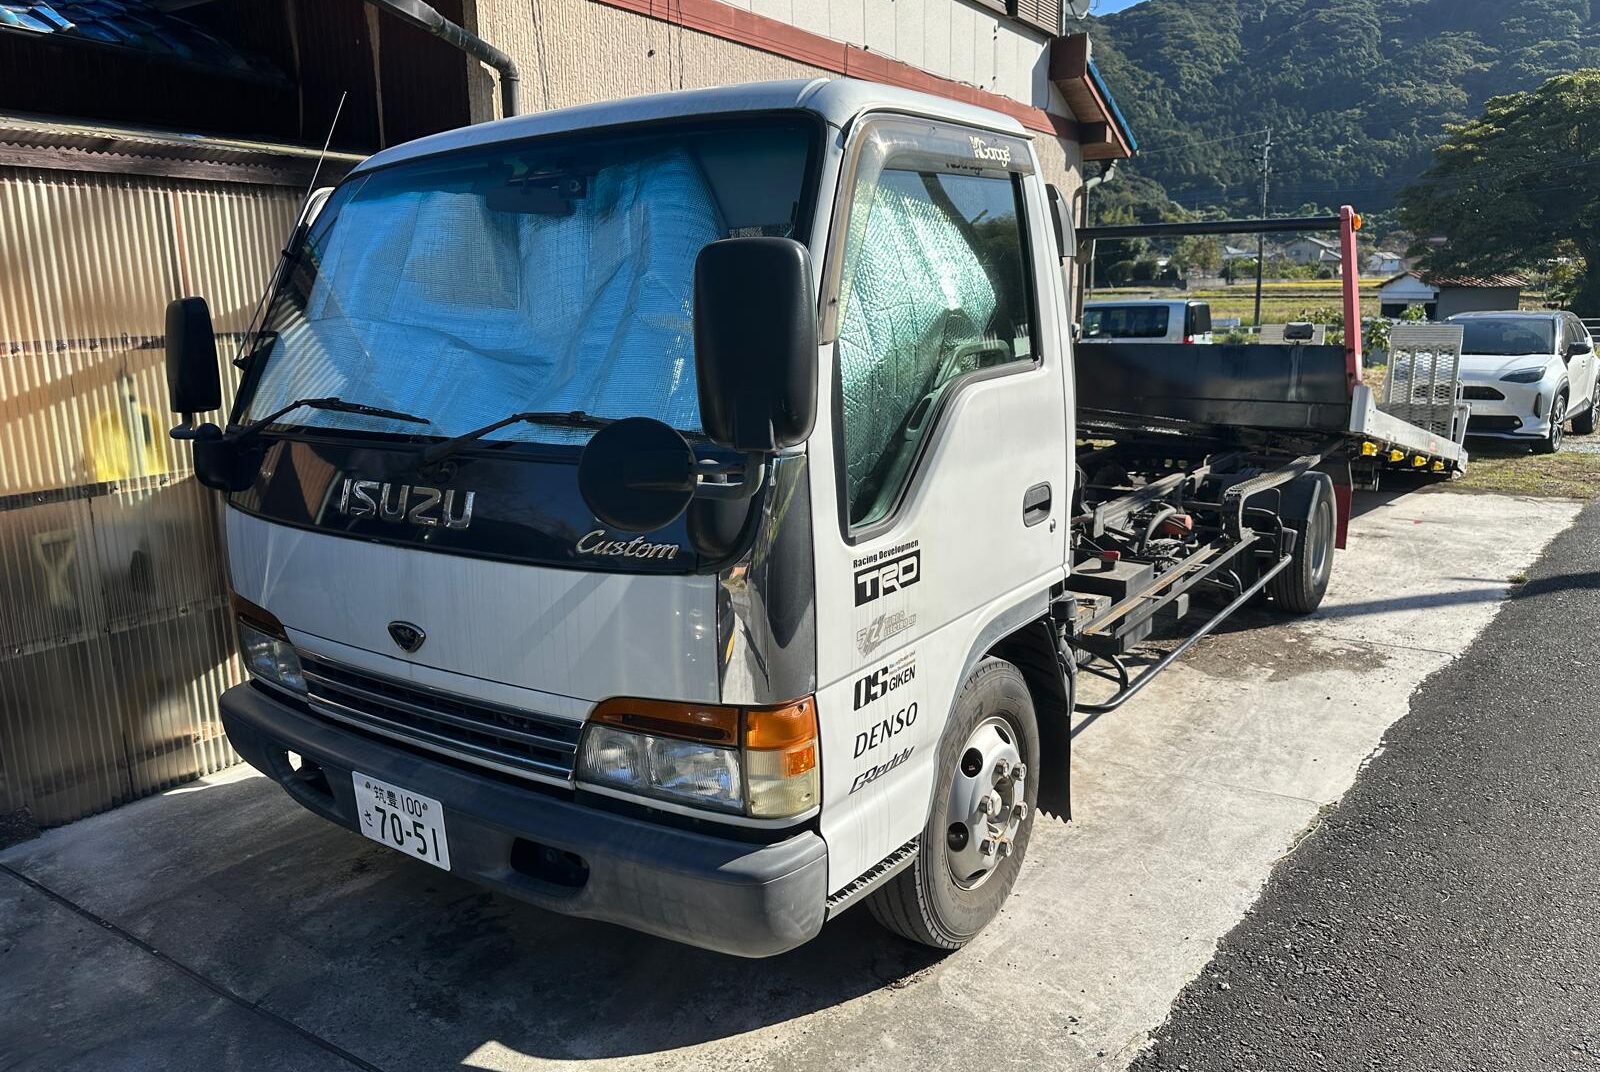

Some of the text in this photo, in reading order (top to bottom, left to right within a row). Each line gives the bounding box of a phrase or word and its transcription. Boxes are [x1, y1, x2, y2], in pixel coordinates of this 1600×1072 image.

[340, 478, 475, 529] ISUZU
[576, 530, 679, 560] Custom
[853, 554, 878, 568] Racing
[856, 552, 920, 604] TRD
[853, 664, 916, 711] OS GIKEN
[854, 702, 918, 759] DENSO
[373, 785, 422, 817] 筑豊 100
[364, 805, 440, 862] さ 70-51
